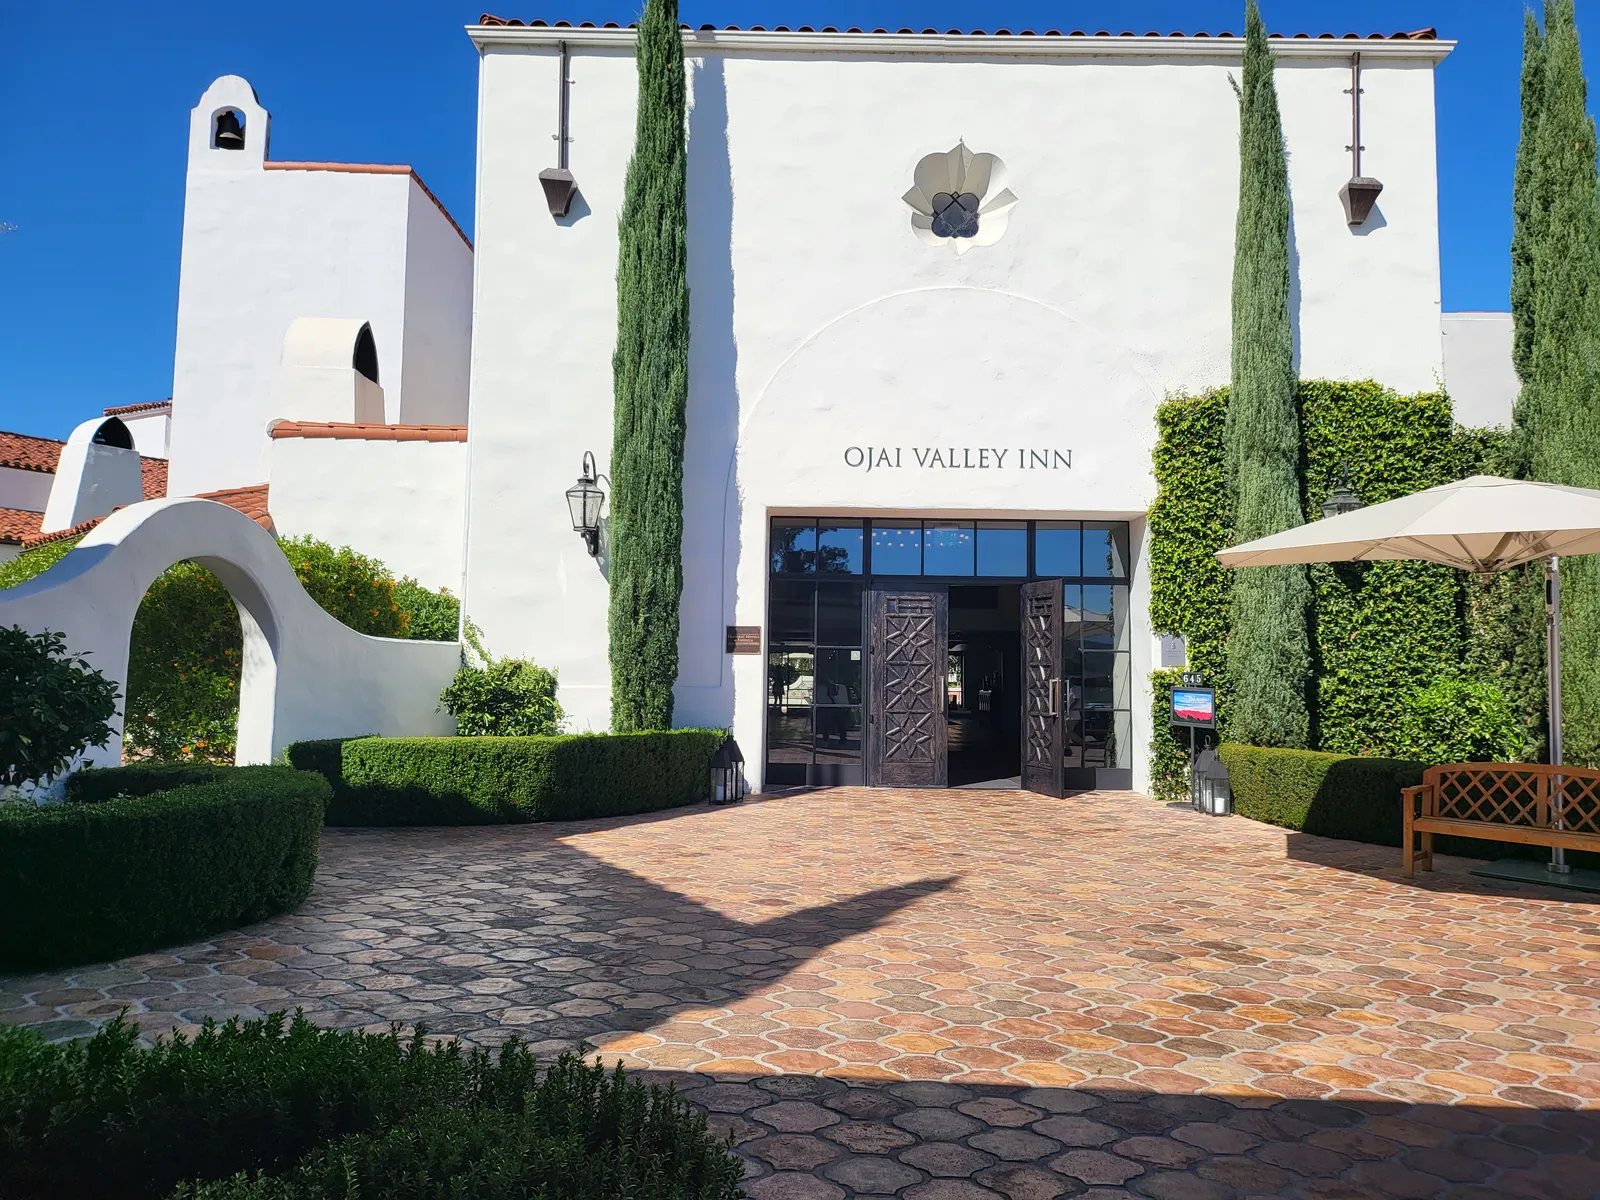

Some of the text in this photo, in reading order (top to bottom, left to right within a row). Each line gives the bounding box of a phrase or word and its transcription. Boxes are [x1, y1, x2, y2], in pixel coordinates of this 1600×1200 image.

[844, 446, 1073, 473] OJAI VALLEY INN
[1183, 674, 1202, 683] 645
